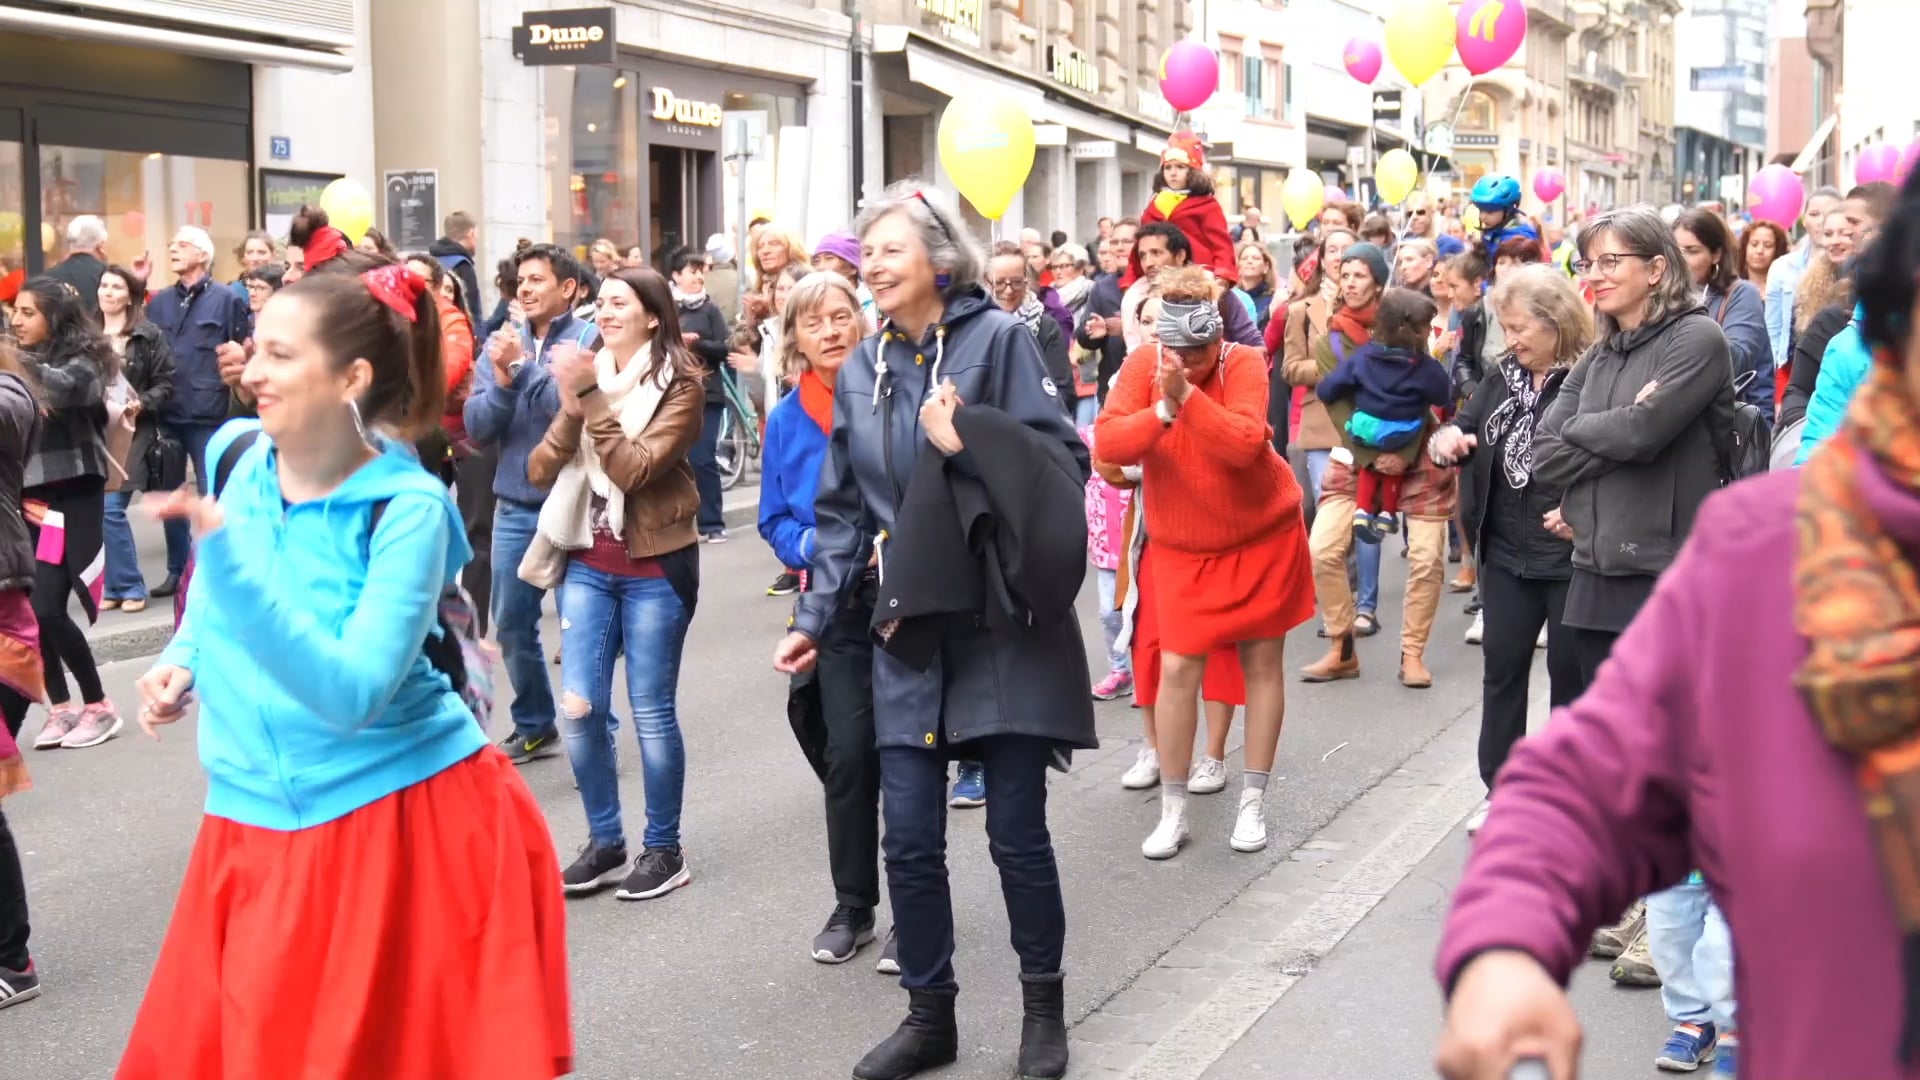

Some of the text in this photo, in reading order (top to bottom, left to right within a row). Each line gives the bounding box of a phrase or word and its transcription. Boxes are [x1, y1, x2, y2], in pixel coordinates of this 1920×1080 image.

[529, 24, 604, 45] Dune
[652, 86, 723, 128] Dune
[273, 139, 288, 156] 75
